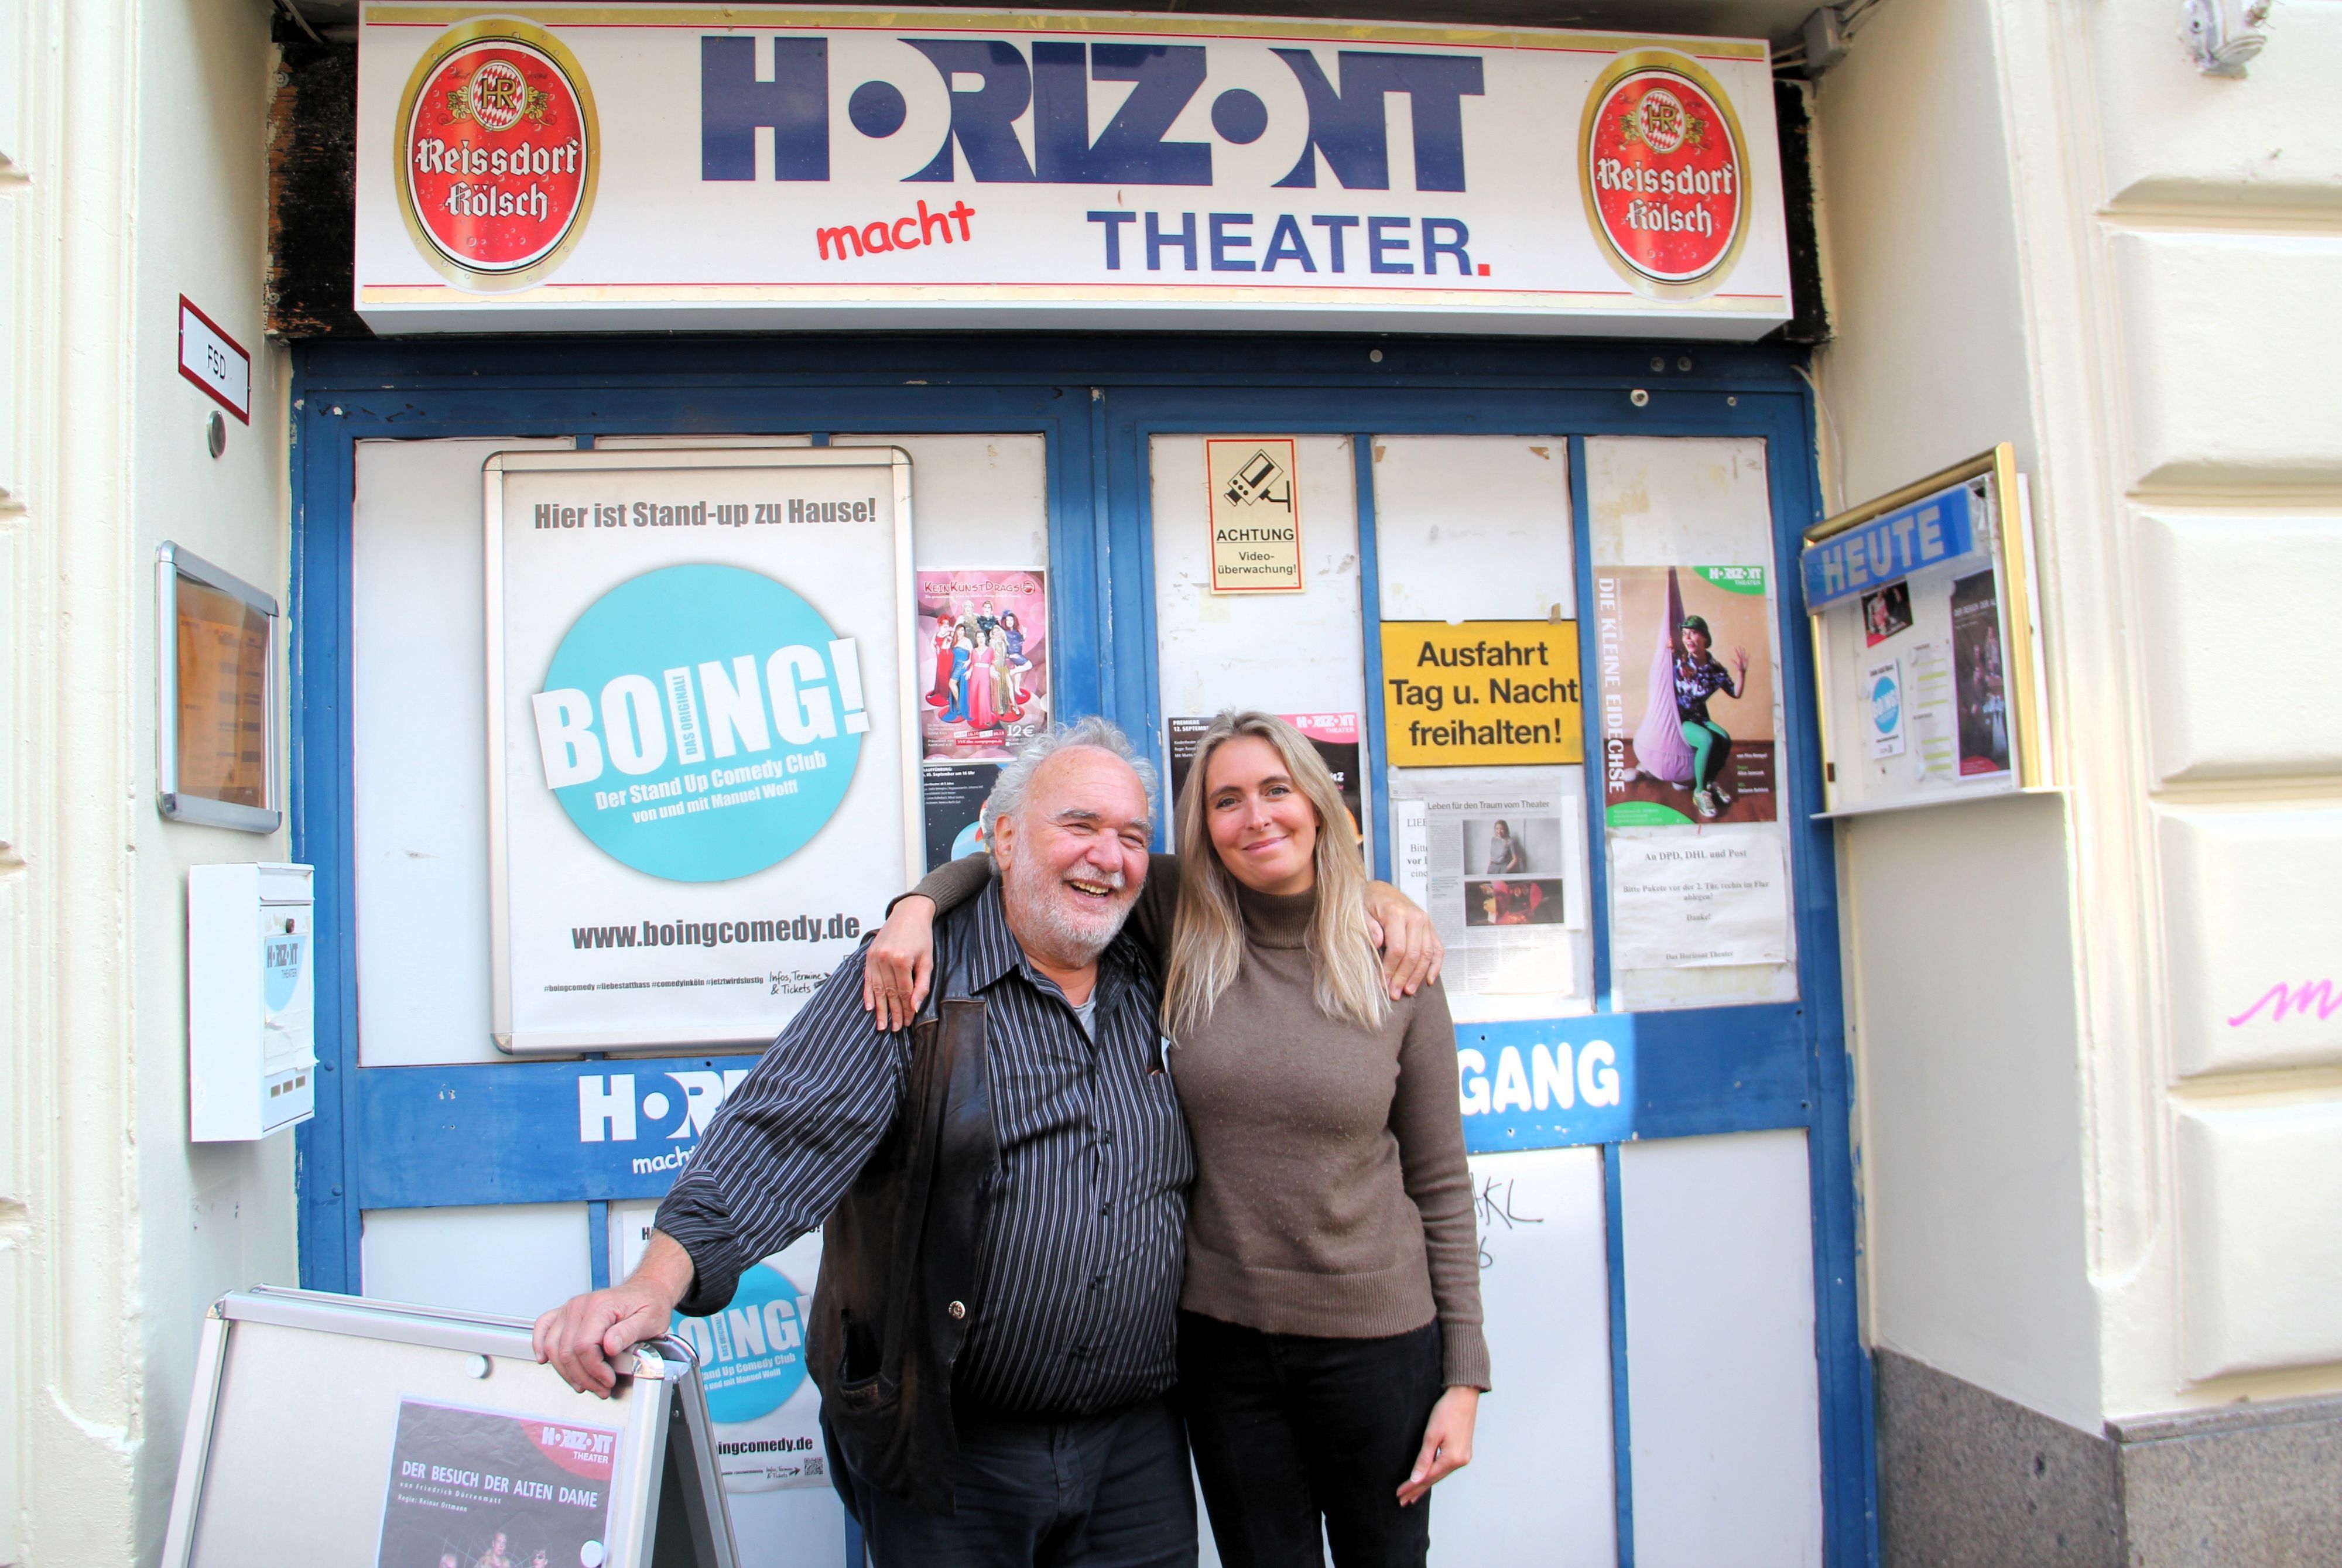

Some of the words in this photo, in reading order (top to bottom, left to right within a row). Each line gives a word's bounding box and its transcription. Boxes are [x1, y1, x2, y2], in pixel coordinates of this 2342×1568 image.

[701, 36, 1484, 193] HORIZONT
[415, 137, 580, 176] Reissdorf
[1597, 158, 1733, 194] Reissdorf
[445, 181, 549, 222] Kölsch
[817, 200, 976, 261] macht
[1626, 198, 1713, 238] Kölsch
[208, 344, 226, 379] FSD
[535, 503, 588, 529] Hier
[594, 502, 626, 528] ist
[633, 501, 749, 528] Stand-up
[755, 503, 781, 524] zu
[789, 498, 876, 524] Hause!
[1216, 528, 1295, 541] ACHTUNG
[1238, 552, 1275, 560] Video-
[1821, 505, 1944, 596] HEUTE
[1218, 564, 1296, 575] überwachung!
[1598, 577, 1615, 611] DIE
[1417, 641, 1549, 667] Ausfahrt
[1600, 618, 1621, 687] KLEINE
[672, 675, 694, 731] ORIGINAL!
[1389, 679, 1443, 711] Tag
[1453, 685, 1480, 704] u.
[1490, 677, 1579, 704] Nacht
[532, 637, 871, 789] BOING!
[685, 732, 699, 756] DAS
[1409, 717, 1562, 746] freihalten!
[1604, 694, 1625, 794] EIDECHSE
[595, 787, 626, 810] Der
[631, 777, 682, 804] Stand
[684, 773, 707, 795] Up
[711, 761, 783, 788] Comedy
[785, 750, 827, 773] Club
[632, 810, 657, 824] von
[659, 802, 684, 819] und
[687, 797, 710, 813] mit
[712, 787, 761, 809] Manuel
[762, 779, 799, 799] Wolff
[1427, 802, 1451, 810] Leben
[1452, 800, 1463, 809] für
[1464, 800, 1478, 809] den
[1479, 800, 1502, 809] Traum
[1521, 800, 1549, 809] Theater
[1644, 852, 1656, 861] An
[1659, 851, 1683, 861] DPD,
[1684, 850, 1707, 860] DHL
[1709, 850, 1726, 858] und
[1728, 848, 1747, 858] Post
[1683, 892, 1713, 901] ablegen!
[571, 913, 861, 950] www.boingcomedy.de
[1687, 913, 1711, 921] Danke!
[282, 968, 297, 978] THEATER
[544, 983, 595, 992] #boingcomedy
[596, 980, 650, 990] #liebestatthass
[652, 978, 705, 988] #comedyinköln
[706, 976, 763, 986] #jetztwirdslustig
[769, 971, 792, 984] Infos,
[792, 970, 822, 981] Termine
[771, 984, 779, 995] &
[781, 982, 811, 994] Tickets
[709, 1380, 723, 1389] und
[724, 1377, 735, 1386] mit
[736, 1373, 762, 1383] Manuel
[762, 1367, 781, 1379] Wolff
[722, 1365, 735, 1375] Up
[735, 1357, 773, 1373] Comedy
[774, 1353, 796, 1365] Club
[541, 1426, 614, 1454] HORIZONT
[573, 1451, 609, 1464] THEATER
[402, 1460, 426, 1479] DER
[431, 1465, 480, 1488] BESUCH
[484, 1474, 509, 1493] DER
[513, 1479, 553, 1500] ALTEN
[558, 1486, 598, 1508] DAME
[416, 1483, 452, 1496] Friedrich
[441, 1501, 467, 1512] Ortmann
